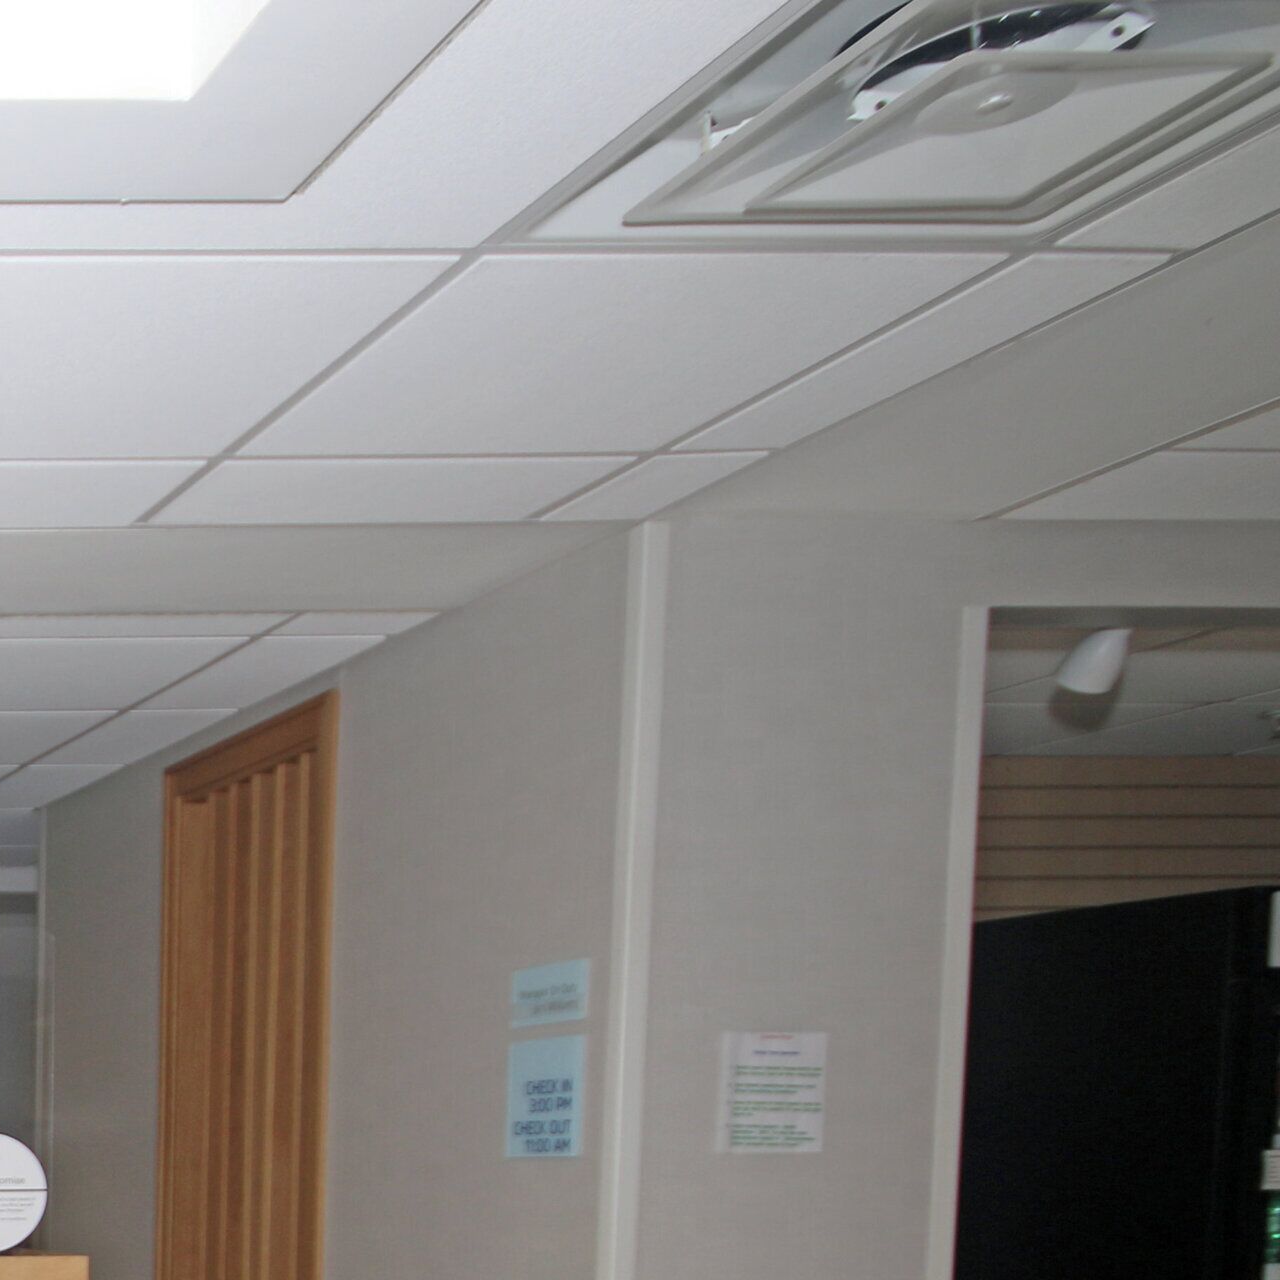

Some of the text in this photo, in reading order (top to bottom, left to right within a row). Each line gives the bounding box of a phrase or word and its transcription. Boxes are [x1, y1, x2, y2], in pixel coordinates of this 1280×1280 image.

[526, 1078, 573, 1095] CHECK IN
[529, 1096, 573, 1113] 3:00 PM
[514, 1119, 572, 1136] CHECK OUT
[554, 1138, 572, 1152] AM
